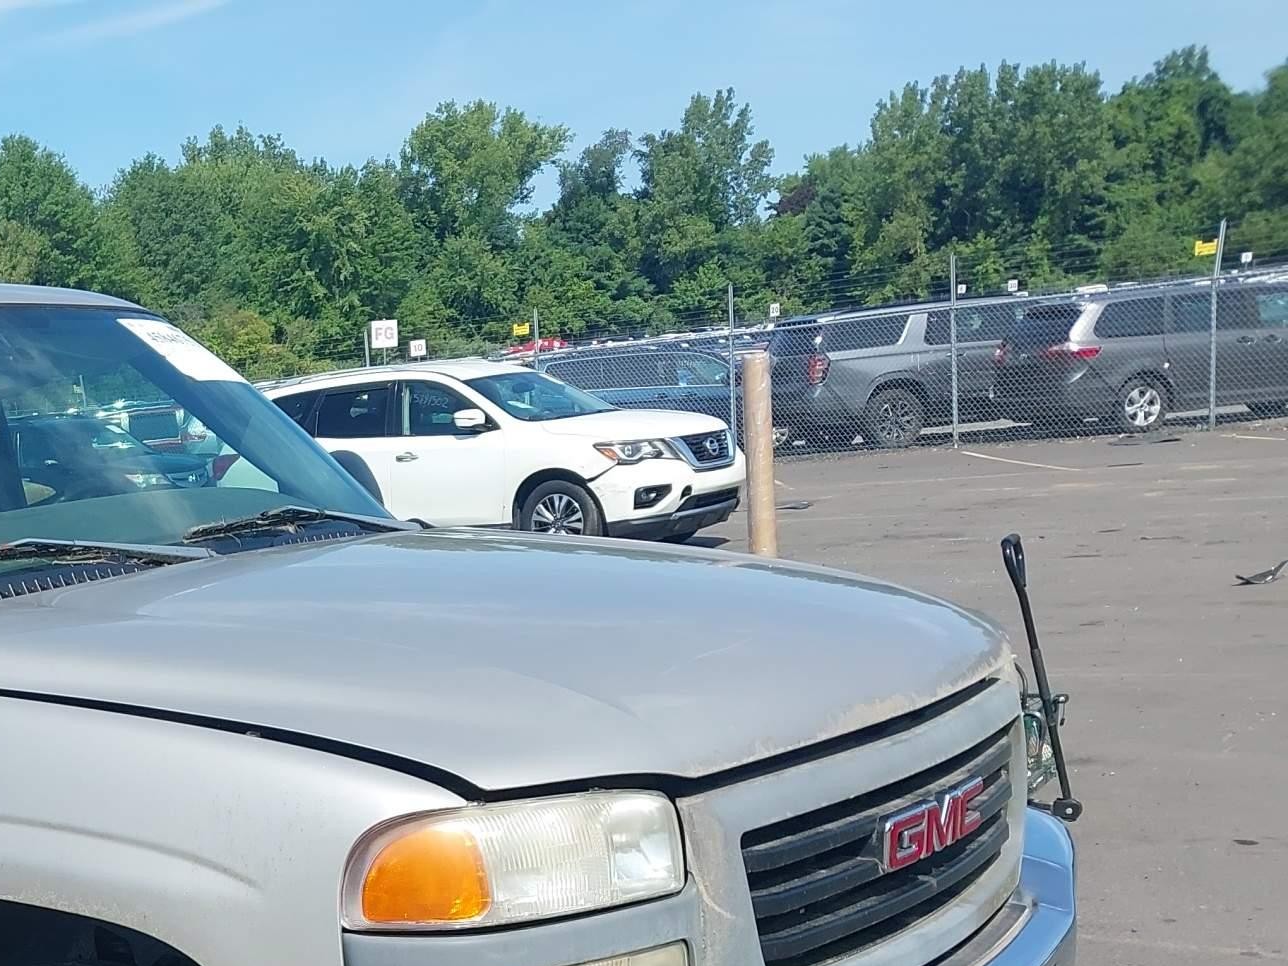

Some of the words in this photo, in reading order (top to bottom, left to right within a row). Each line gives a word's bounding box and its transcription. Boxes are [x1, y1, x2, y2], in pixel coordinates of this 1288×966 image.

[374, 326, 395, 341] FG
[413, 343, 423, 353] 10
[883, 776, 984, 873] GMC
